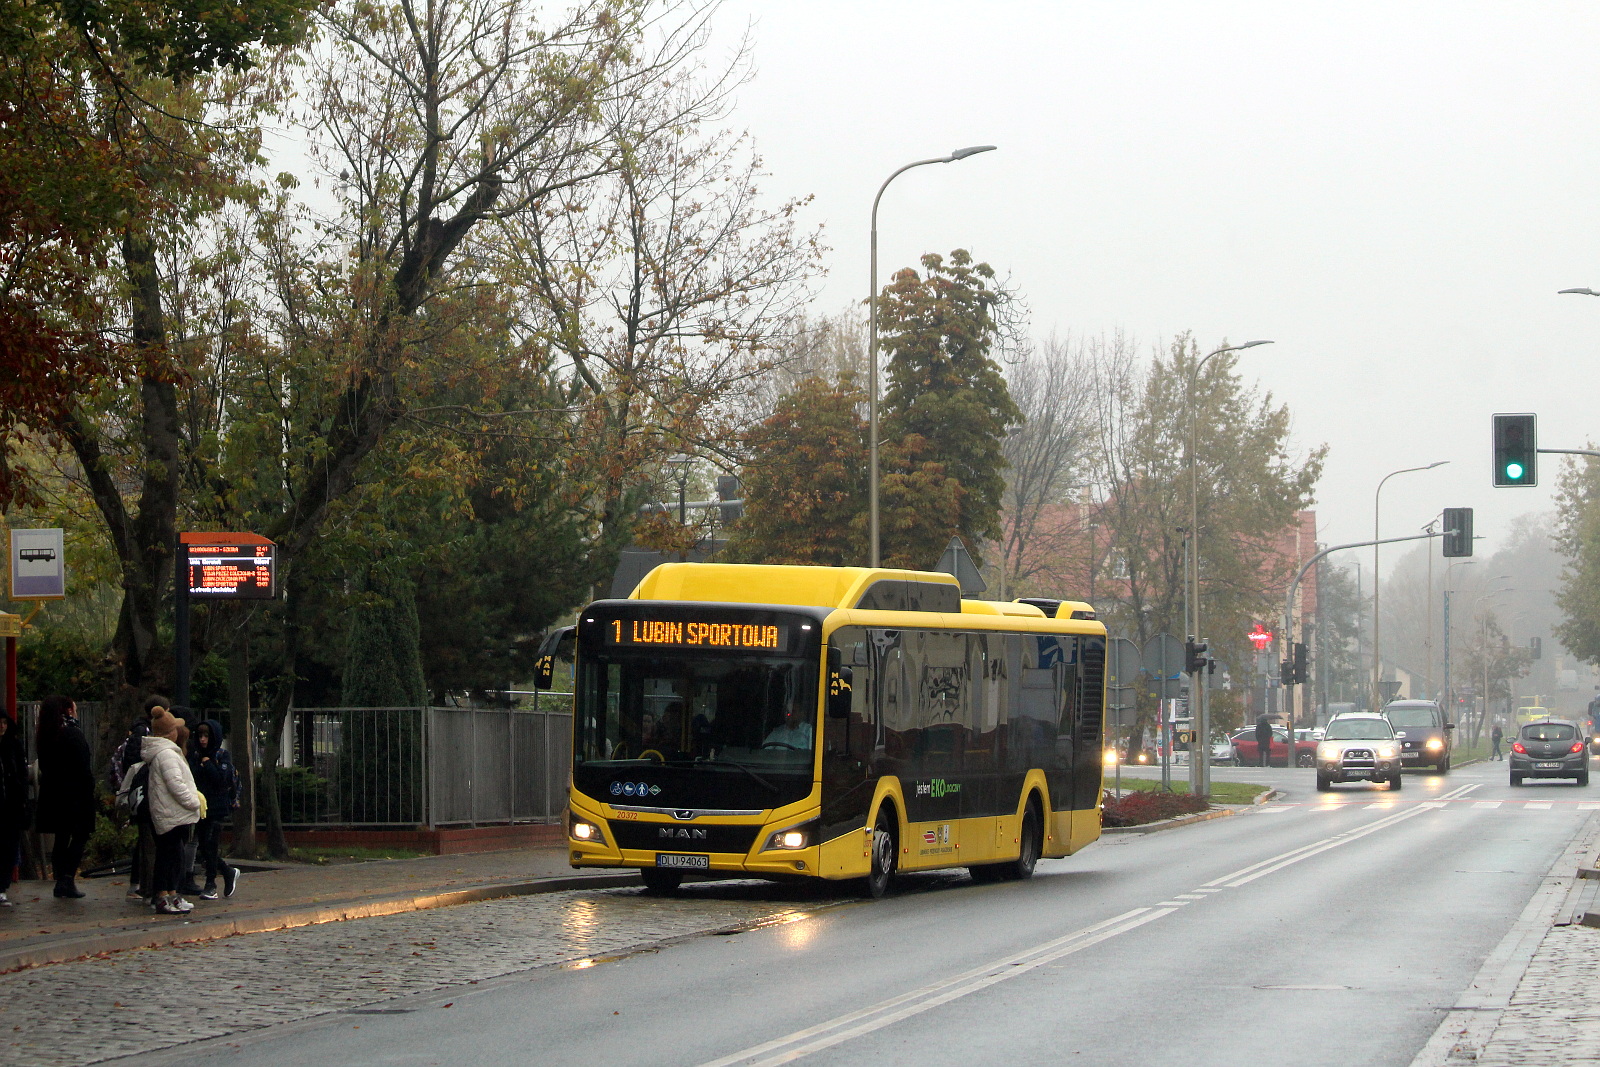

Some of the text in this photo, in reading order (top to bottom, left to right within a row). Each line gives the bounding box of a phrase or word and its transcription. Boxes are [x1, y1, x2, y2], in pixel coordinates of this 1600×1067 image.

[612, 620, 778, 648] 1 LUBIN SPORTOWA
[542, 655, 552, 676] MAN
[830, 672, 839, 695] MAN
[659, 827, 707, 839] MAN
[661, 855, 707, 867] DLU 94063
